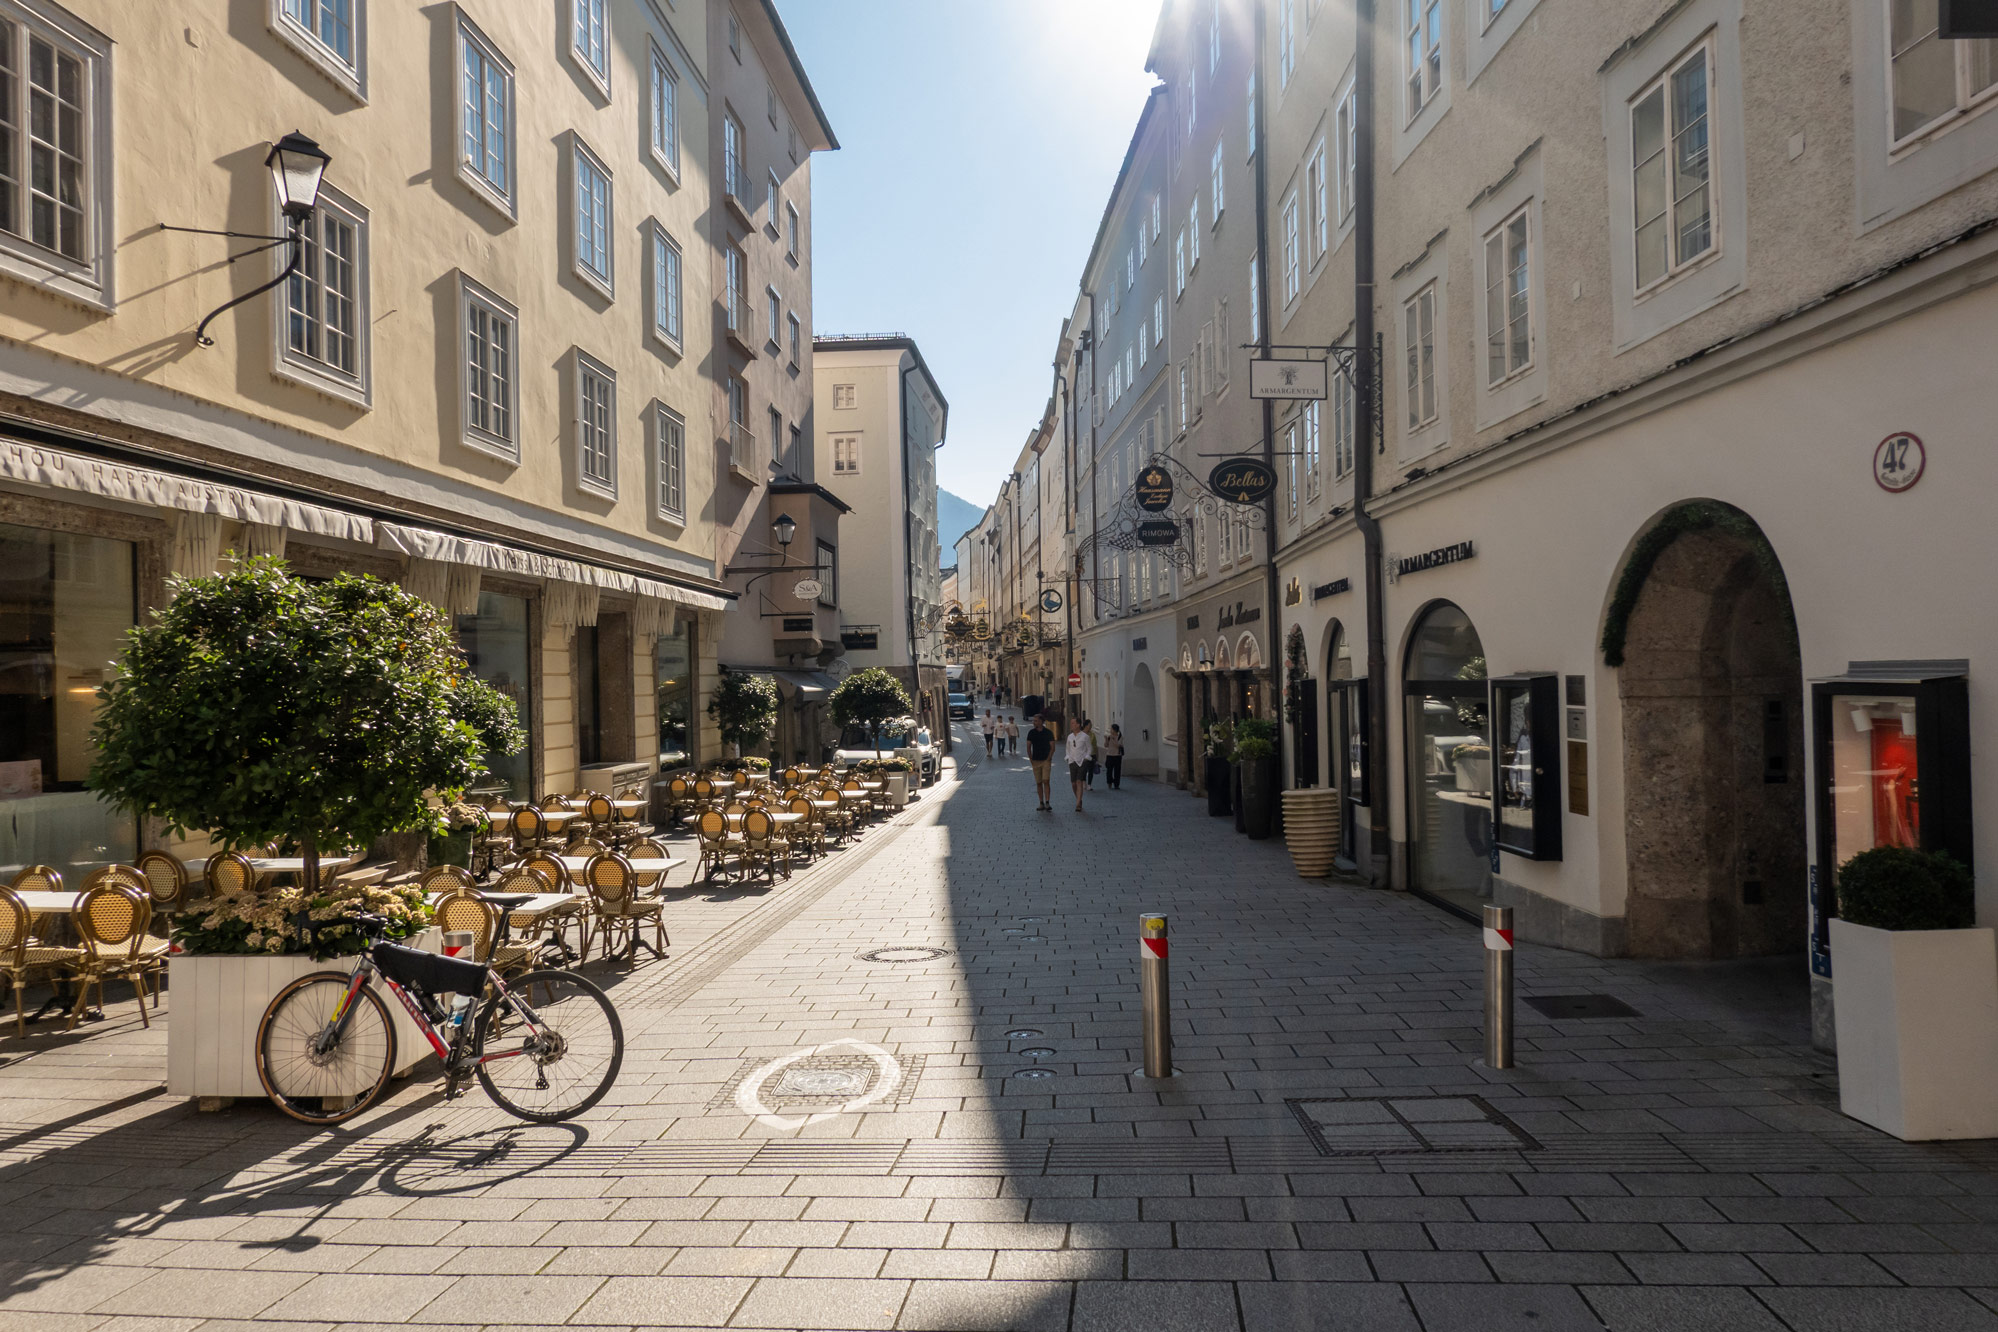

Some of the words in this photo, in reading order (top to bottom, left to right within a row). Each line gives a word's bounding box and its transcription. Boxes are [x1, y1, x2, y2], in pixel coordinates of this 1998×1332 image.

[1259, 387, 1319, 395] ARMARGENTUM
[1883, 438, 1909, 473] 47
[0, 444, 75, 477] HOU,
[92, 463, 164, 490] HAPPY
[178, 482, 257, 508] AUSTRIA
[1220, 470, 1265, 487] Bellas
[1142, 529, 1175, 537] RIMOWA
[1397, 540, 1474, 576] ARMARGENTUM
